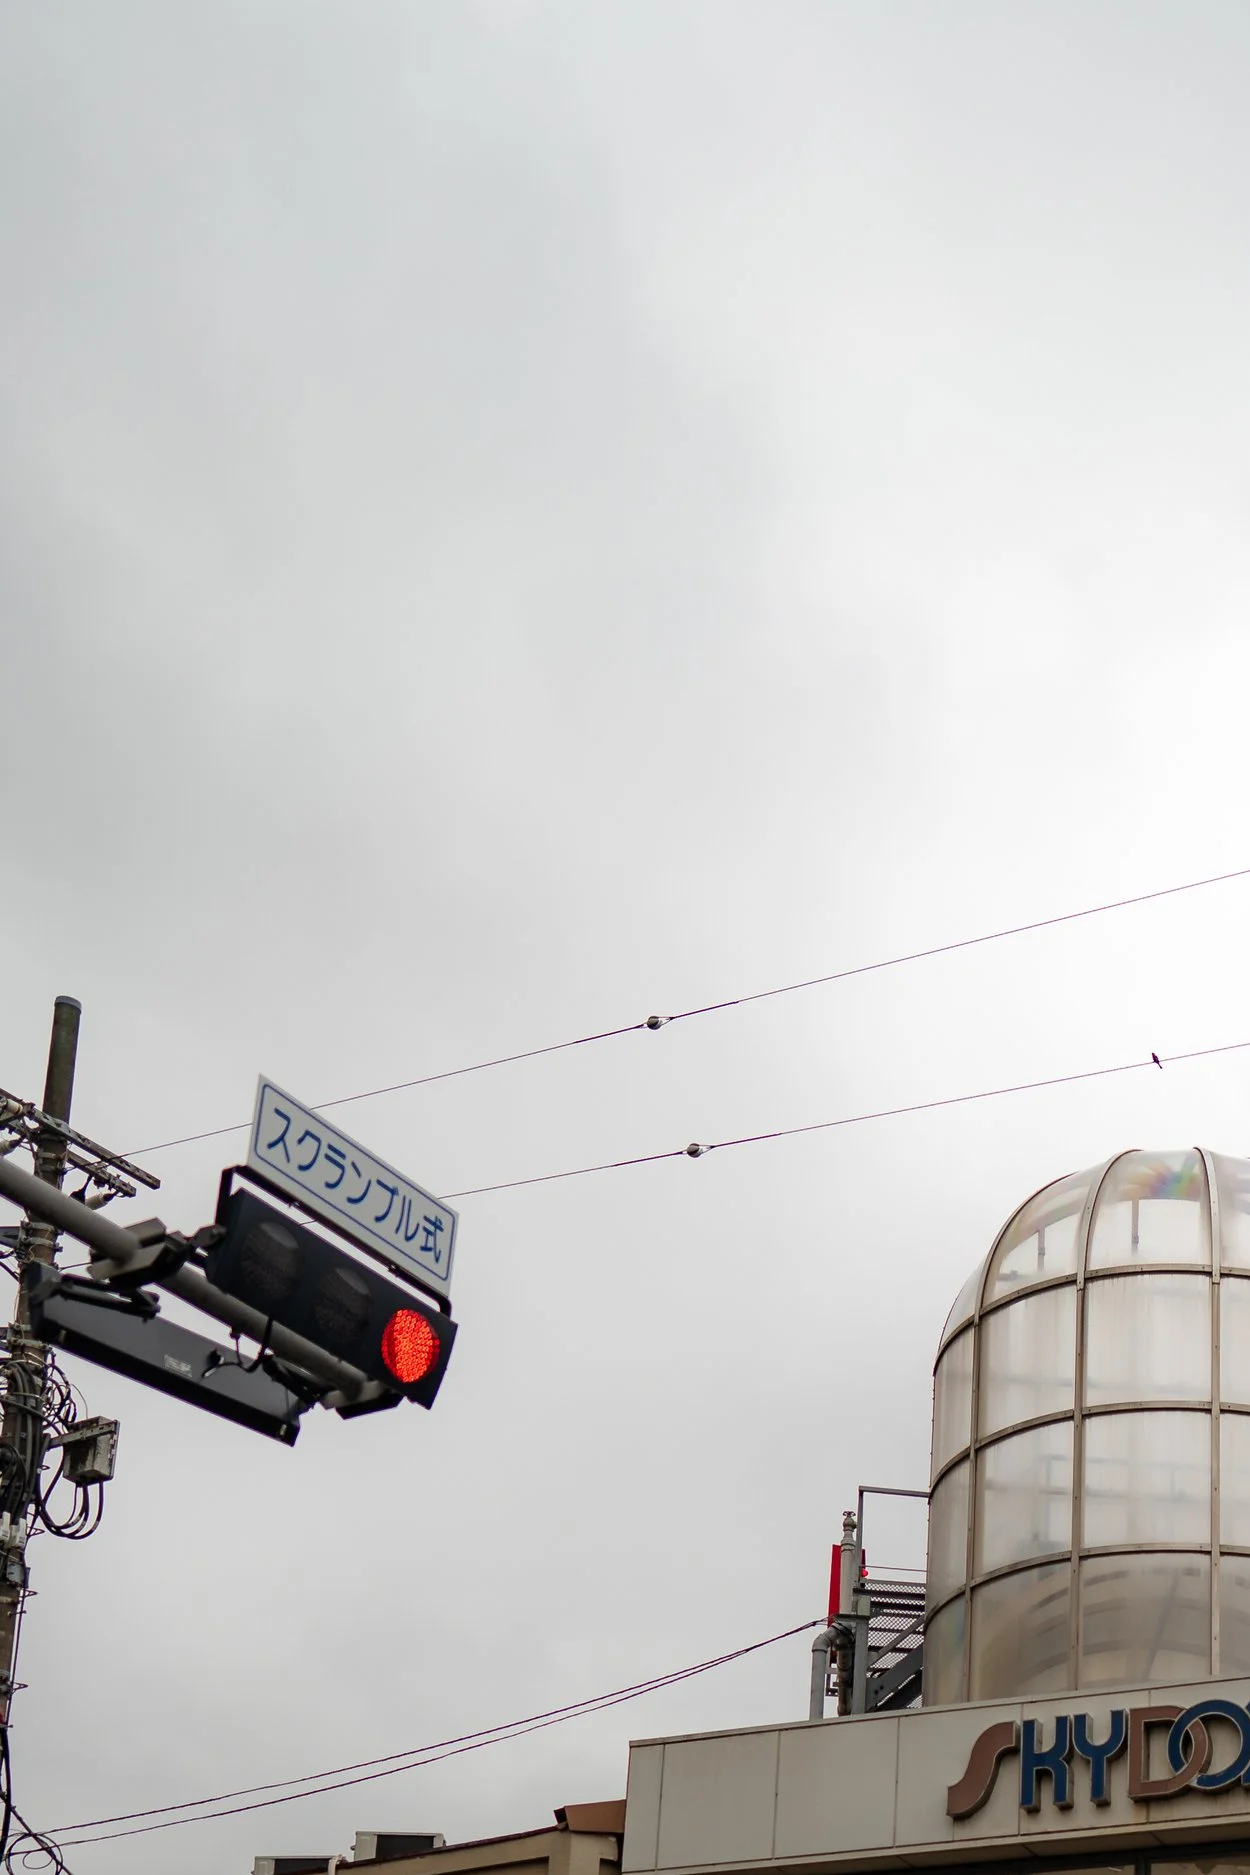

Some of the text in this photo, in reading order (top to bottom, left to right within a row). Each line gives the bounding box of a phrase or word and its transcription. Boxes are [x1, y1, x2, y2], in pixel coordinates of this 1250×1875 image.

[267, 1107, 445, 1264] スクランブル式
